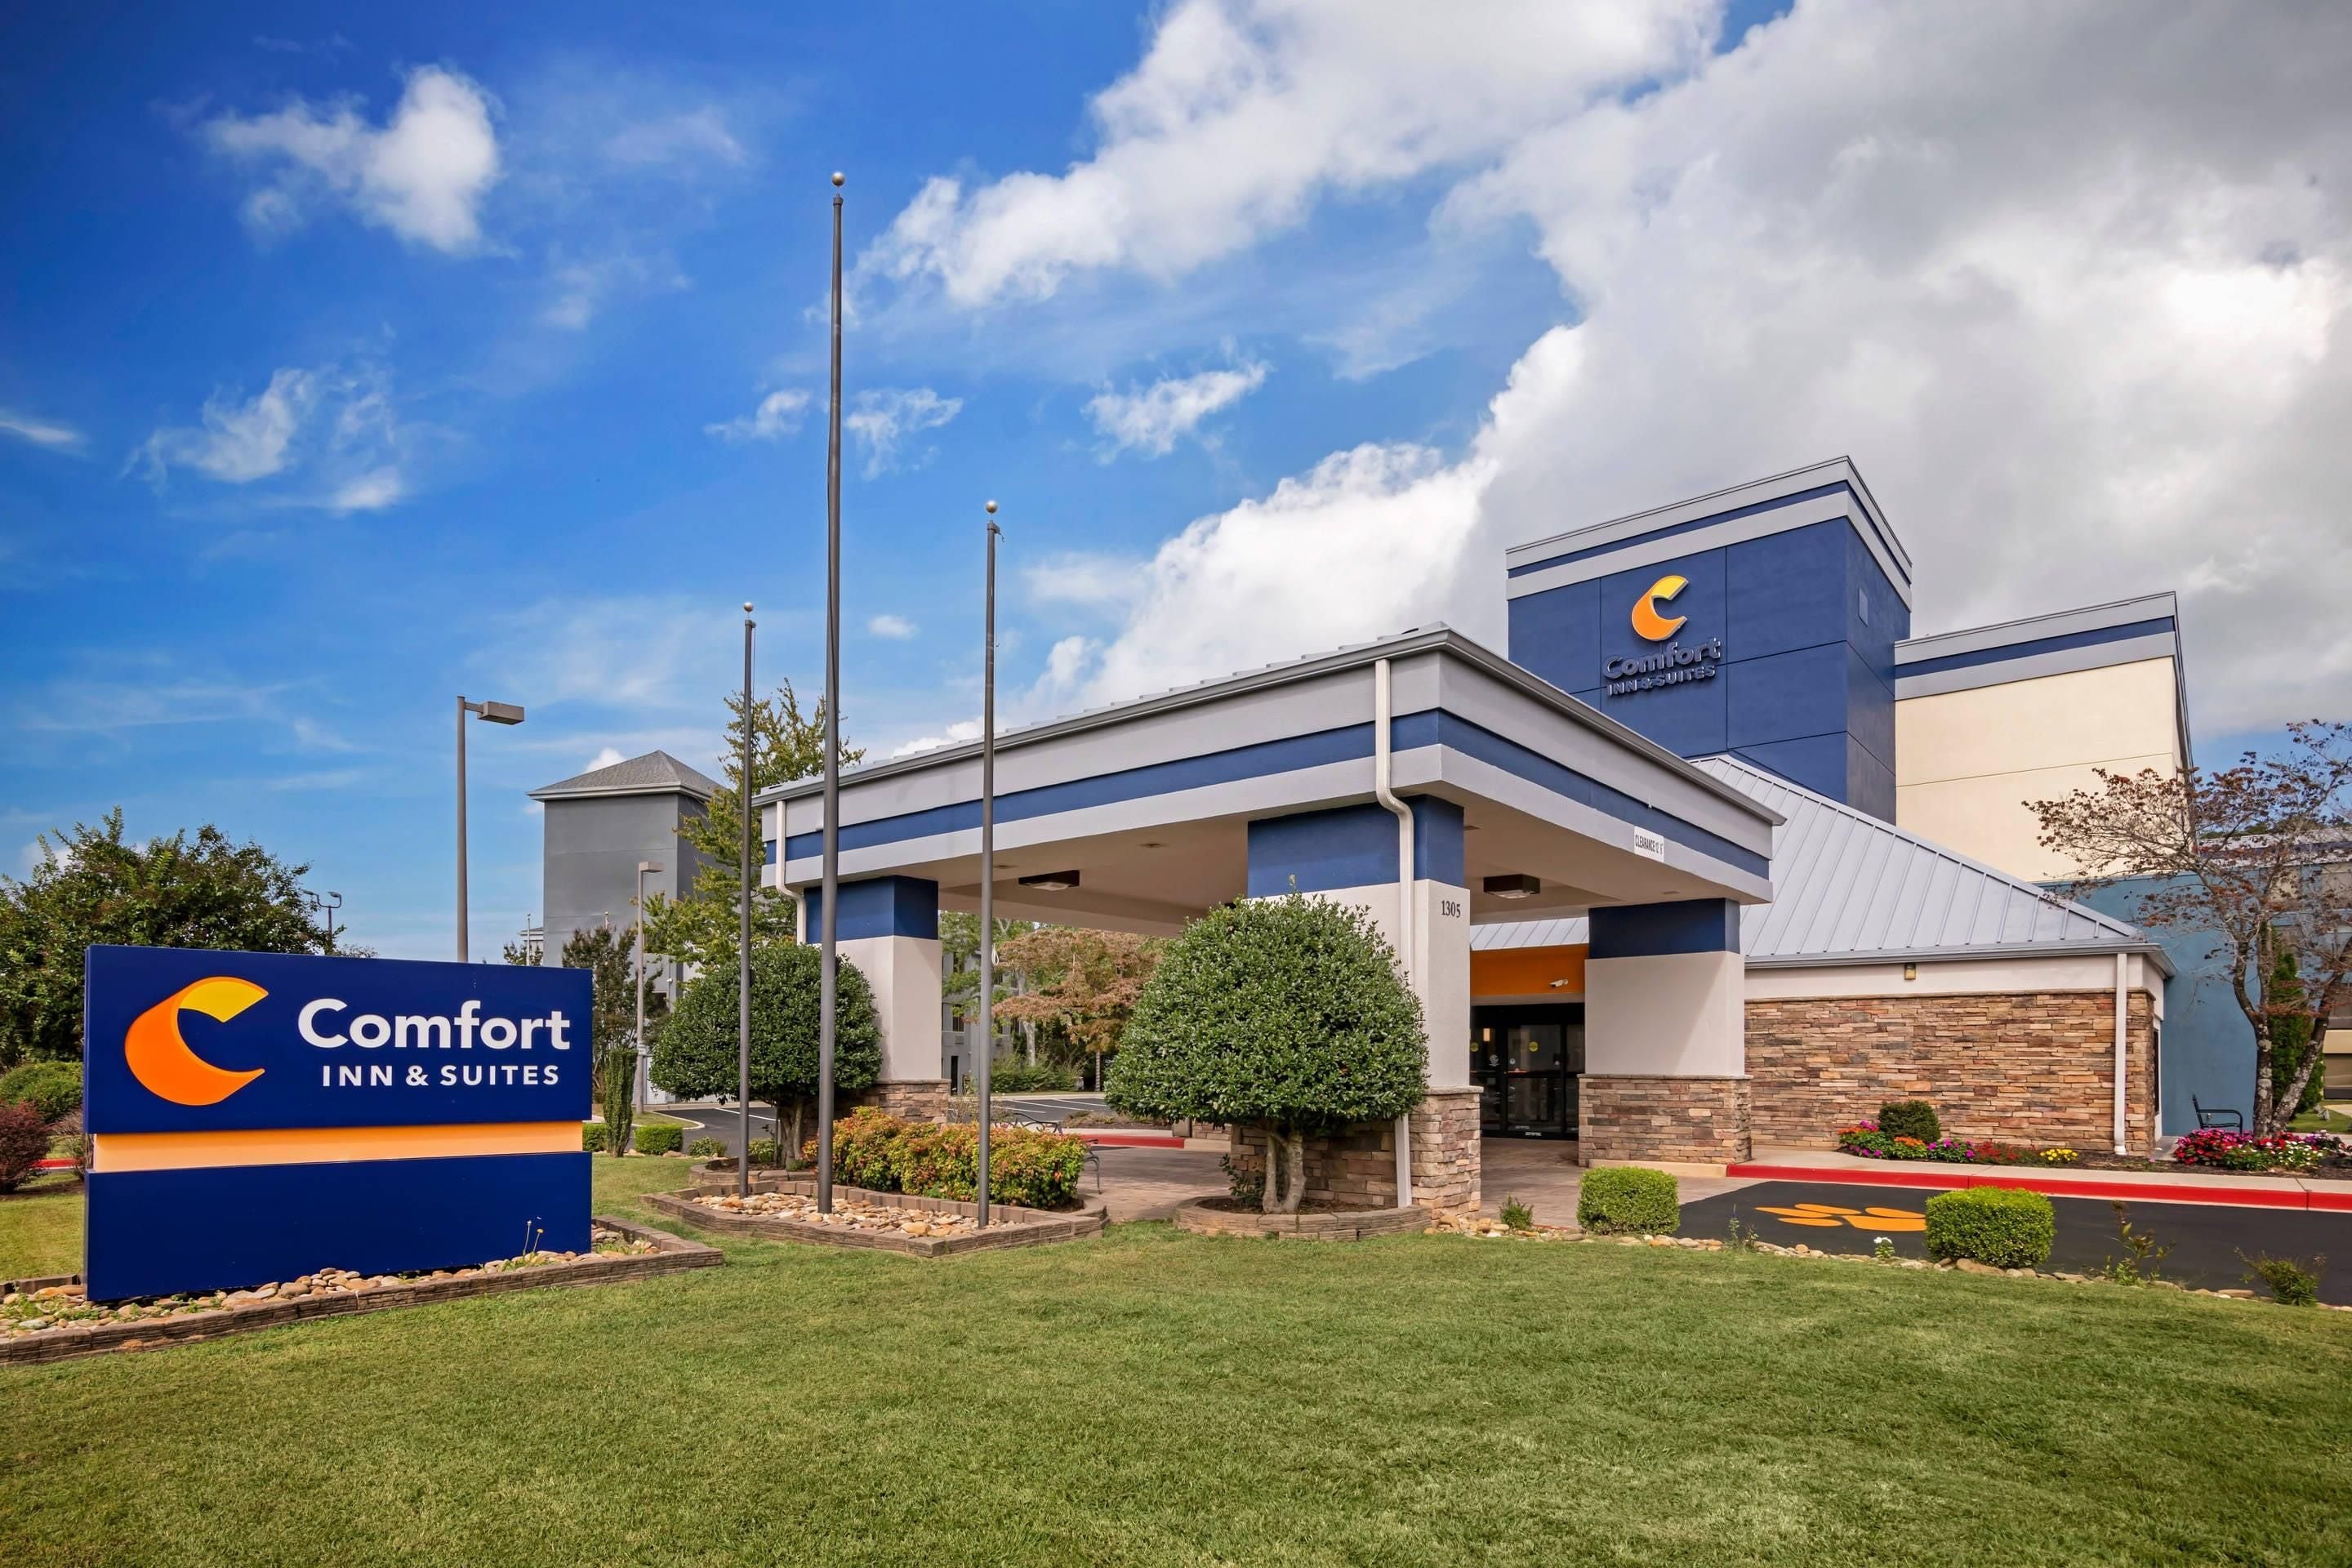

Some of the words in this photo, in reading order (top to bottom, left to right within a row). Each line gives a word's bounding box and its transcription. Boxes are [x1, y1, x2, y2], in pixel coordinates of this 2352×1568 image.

[1603, 637, 1721, 679] Comfort
[1607, 679, 1637, 696] INN
[1638, 677, 1652, 689] &
[1653, 665, 1715, 687] SUITES
[1635, 834, 1655, 852] CLEARANCE
[1441, 900, 1461, 918] 1305
[298, 998, 570, 1049] Comfort
[323, 1065, 392, 1086] INN
[405, 1065, 429, 1086] &
[440, 1065, 559, 1086] SUITES
